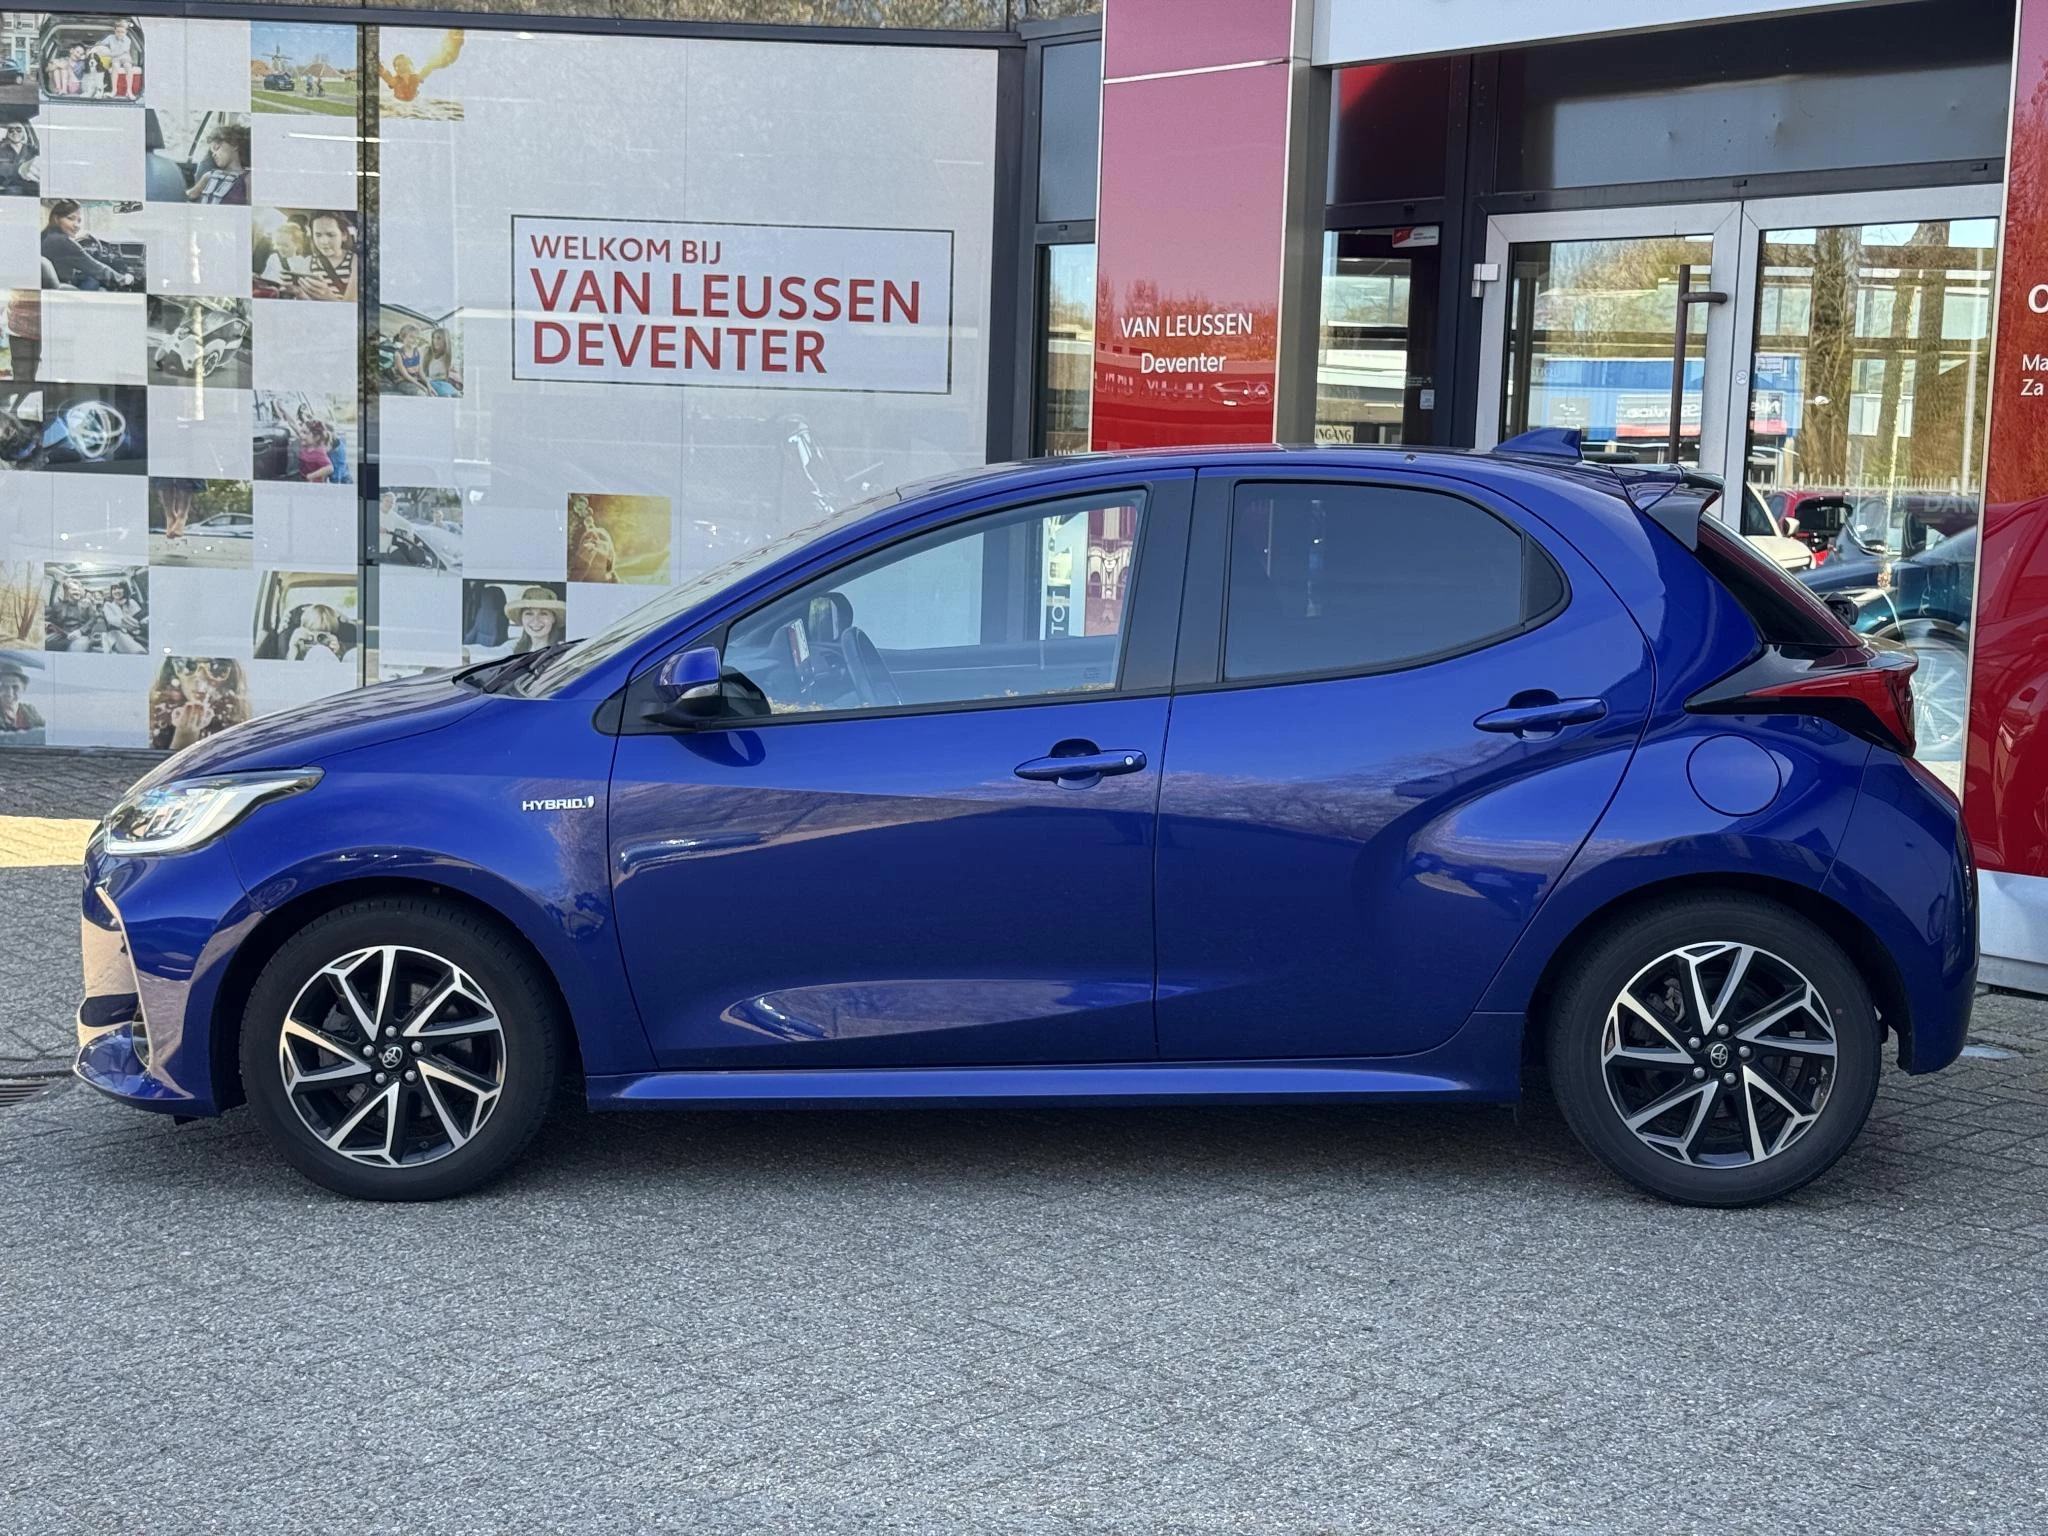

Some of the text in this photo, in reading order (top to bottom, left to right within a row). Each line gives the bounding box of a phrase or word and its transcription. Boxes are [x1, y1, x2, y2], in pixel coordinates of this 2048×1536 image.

[530, 234, 722, 265] WELKOM BIJ
[530, 268, 920, 324] VAN LEUSSEN
[1120, 313, 1253, 339] VAN LEUSSEN
[533, 321, 827, 374] DEVENTER
[1140, 353, 1227, 374] Deventer
[2020, 379, 2044, 397] Za
